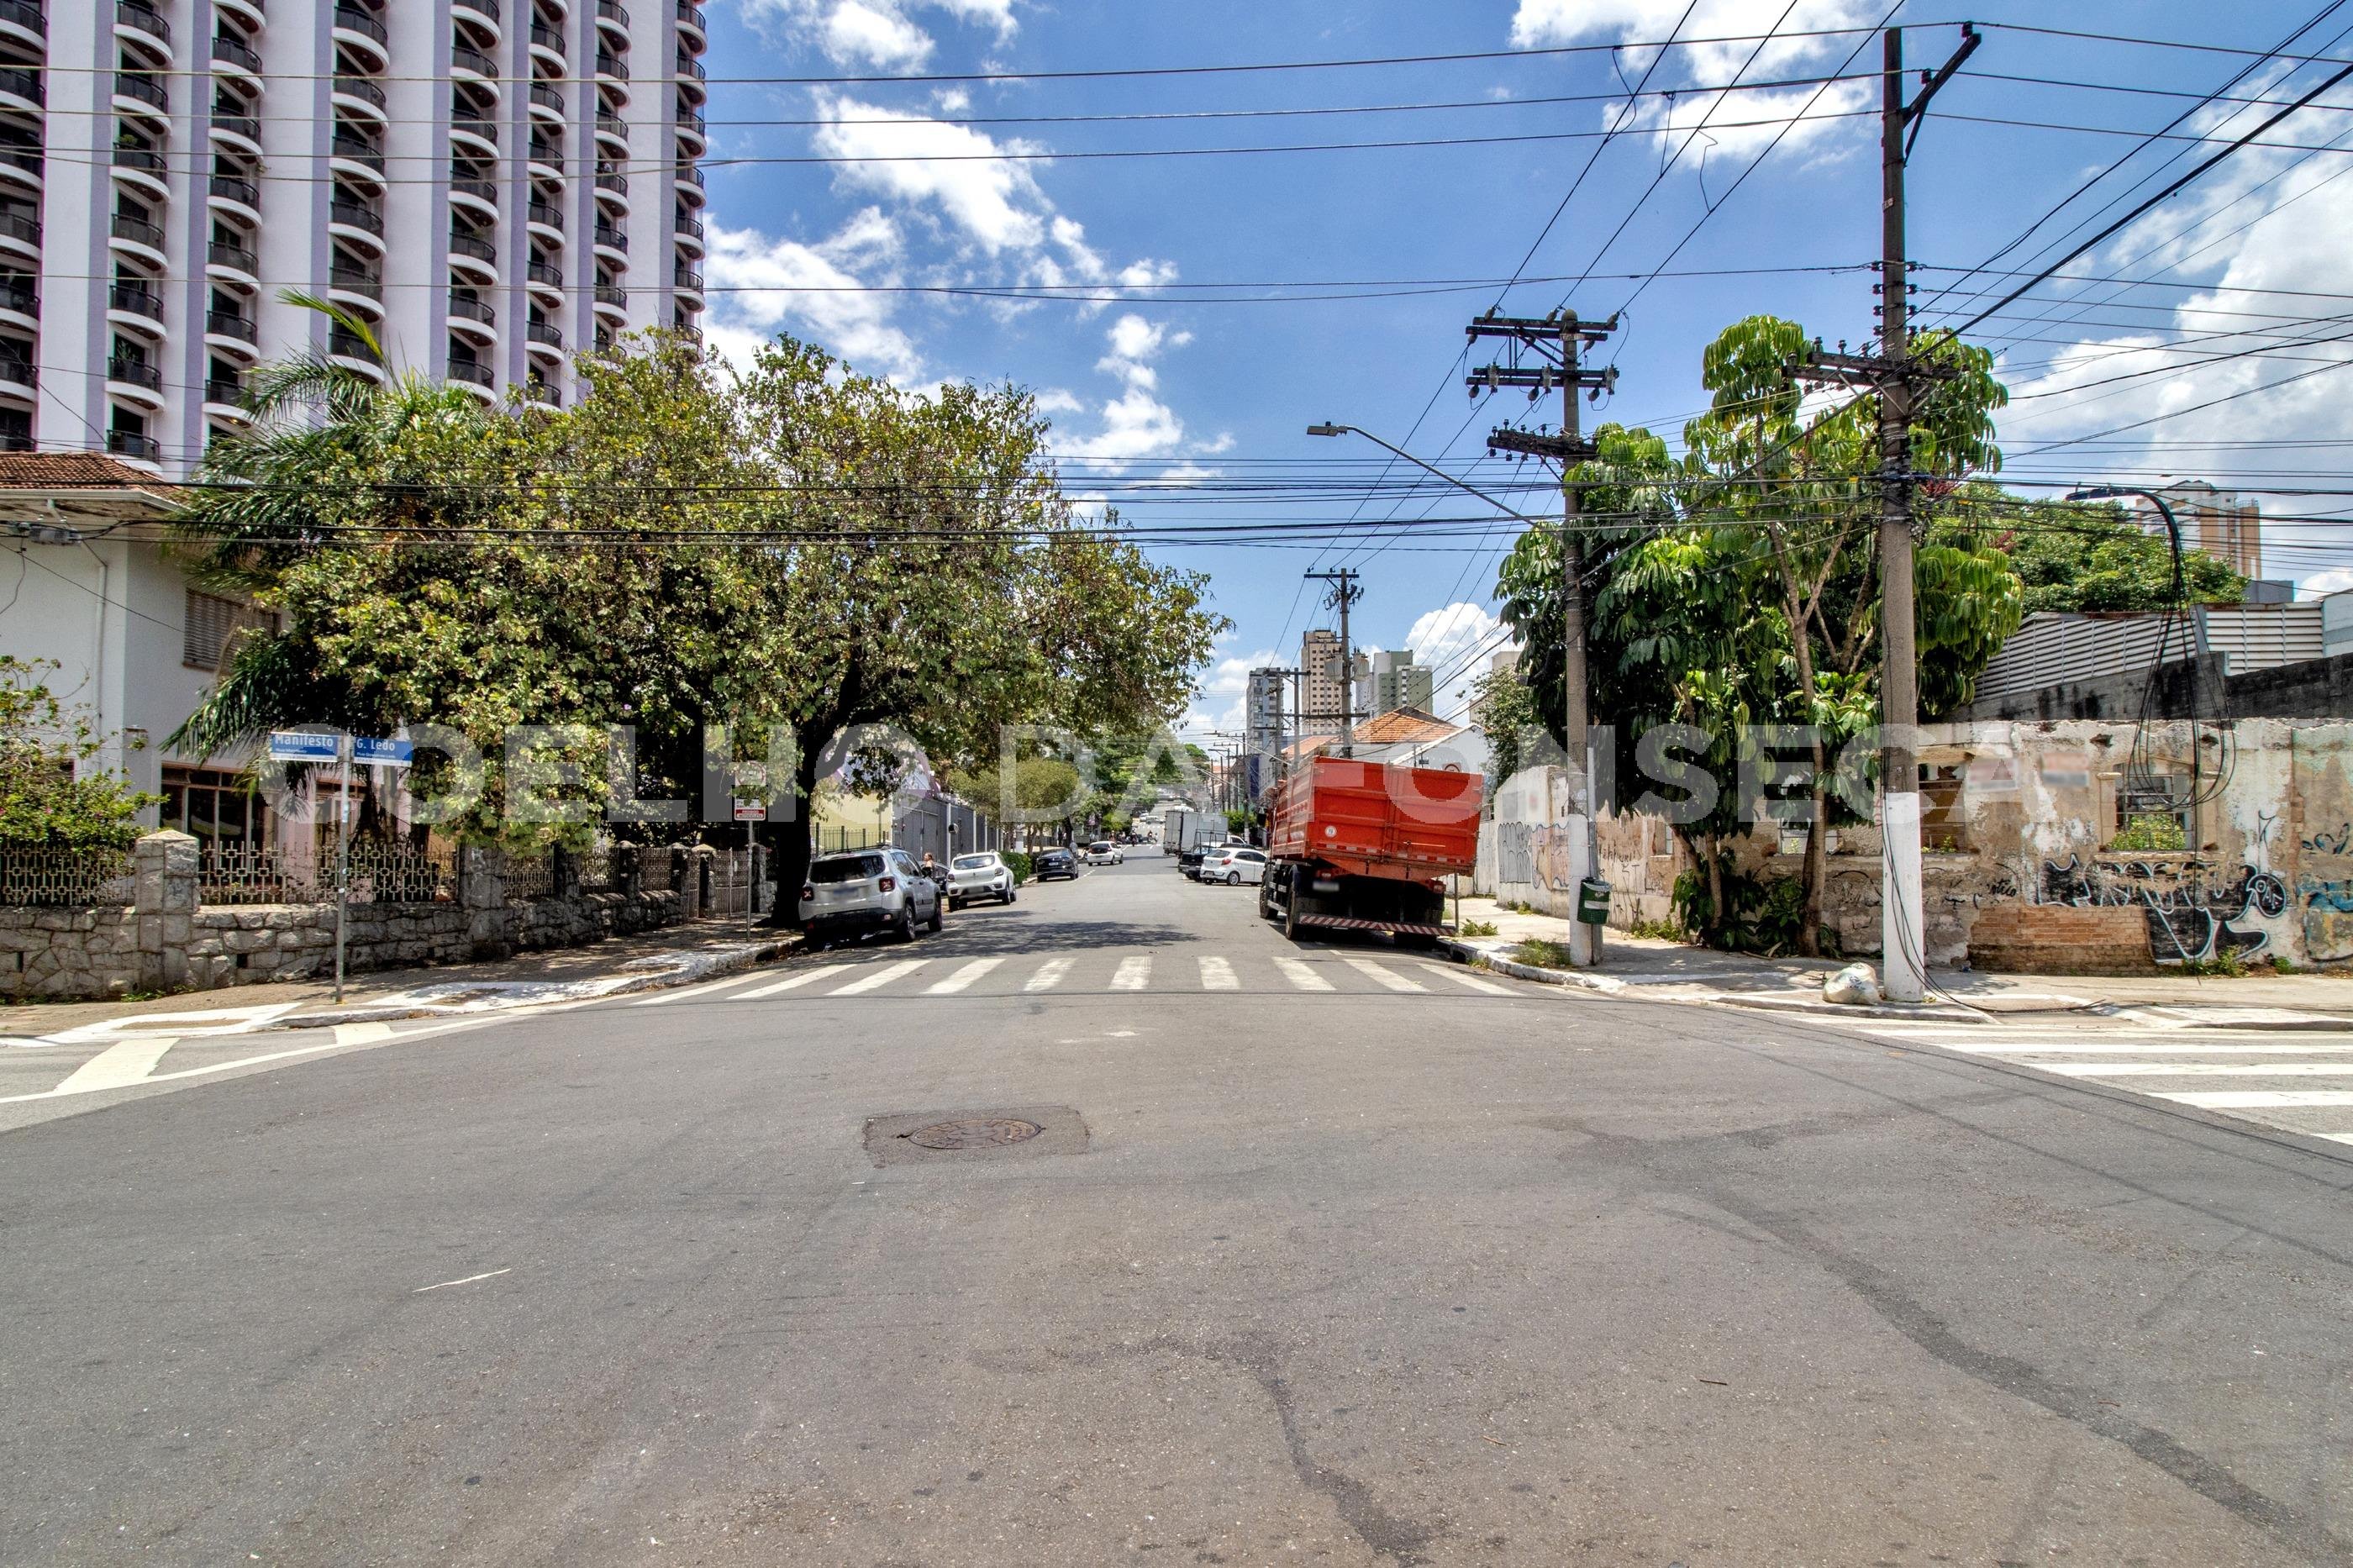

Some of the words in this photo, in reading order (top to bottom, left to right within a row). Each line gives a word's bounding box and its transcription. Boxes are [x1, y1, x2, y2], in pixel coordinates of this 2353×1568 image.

[274, 734, 334, 747] Manifesto
[356, 738, 367, 750] G.
[371, 739, 396, 752] Ledo
